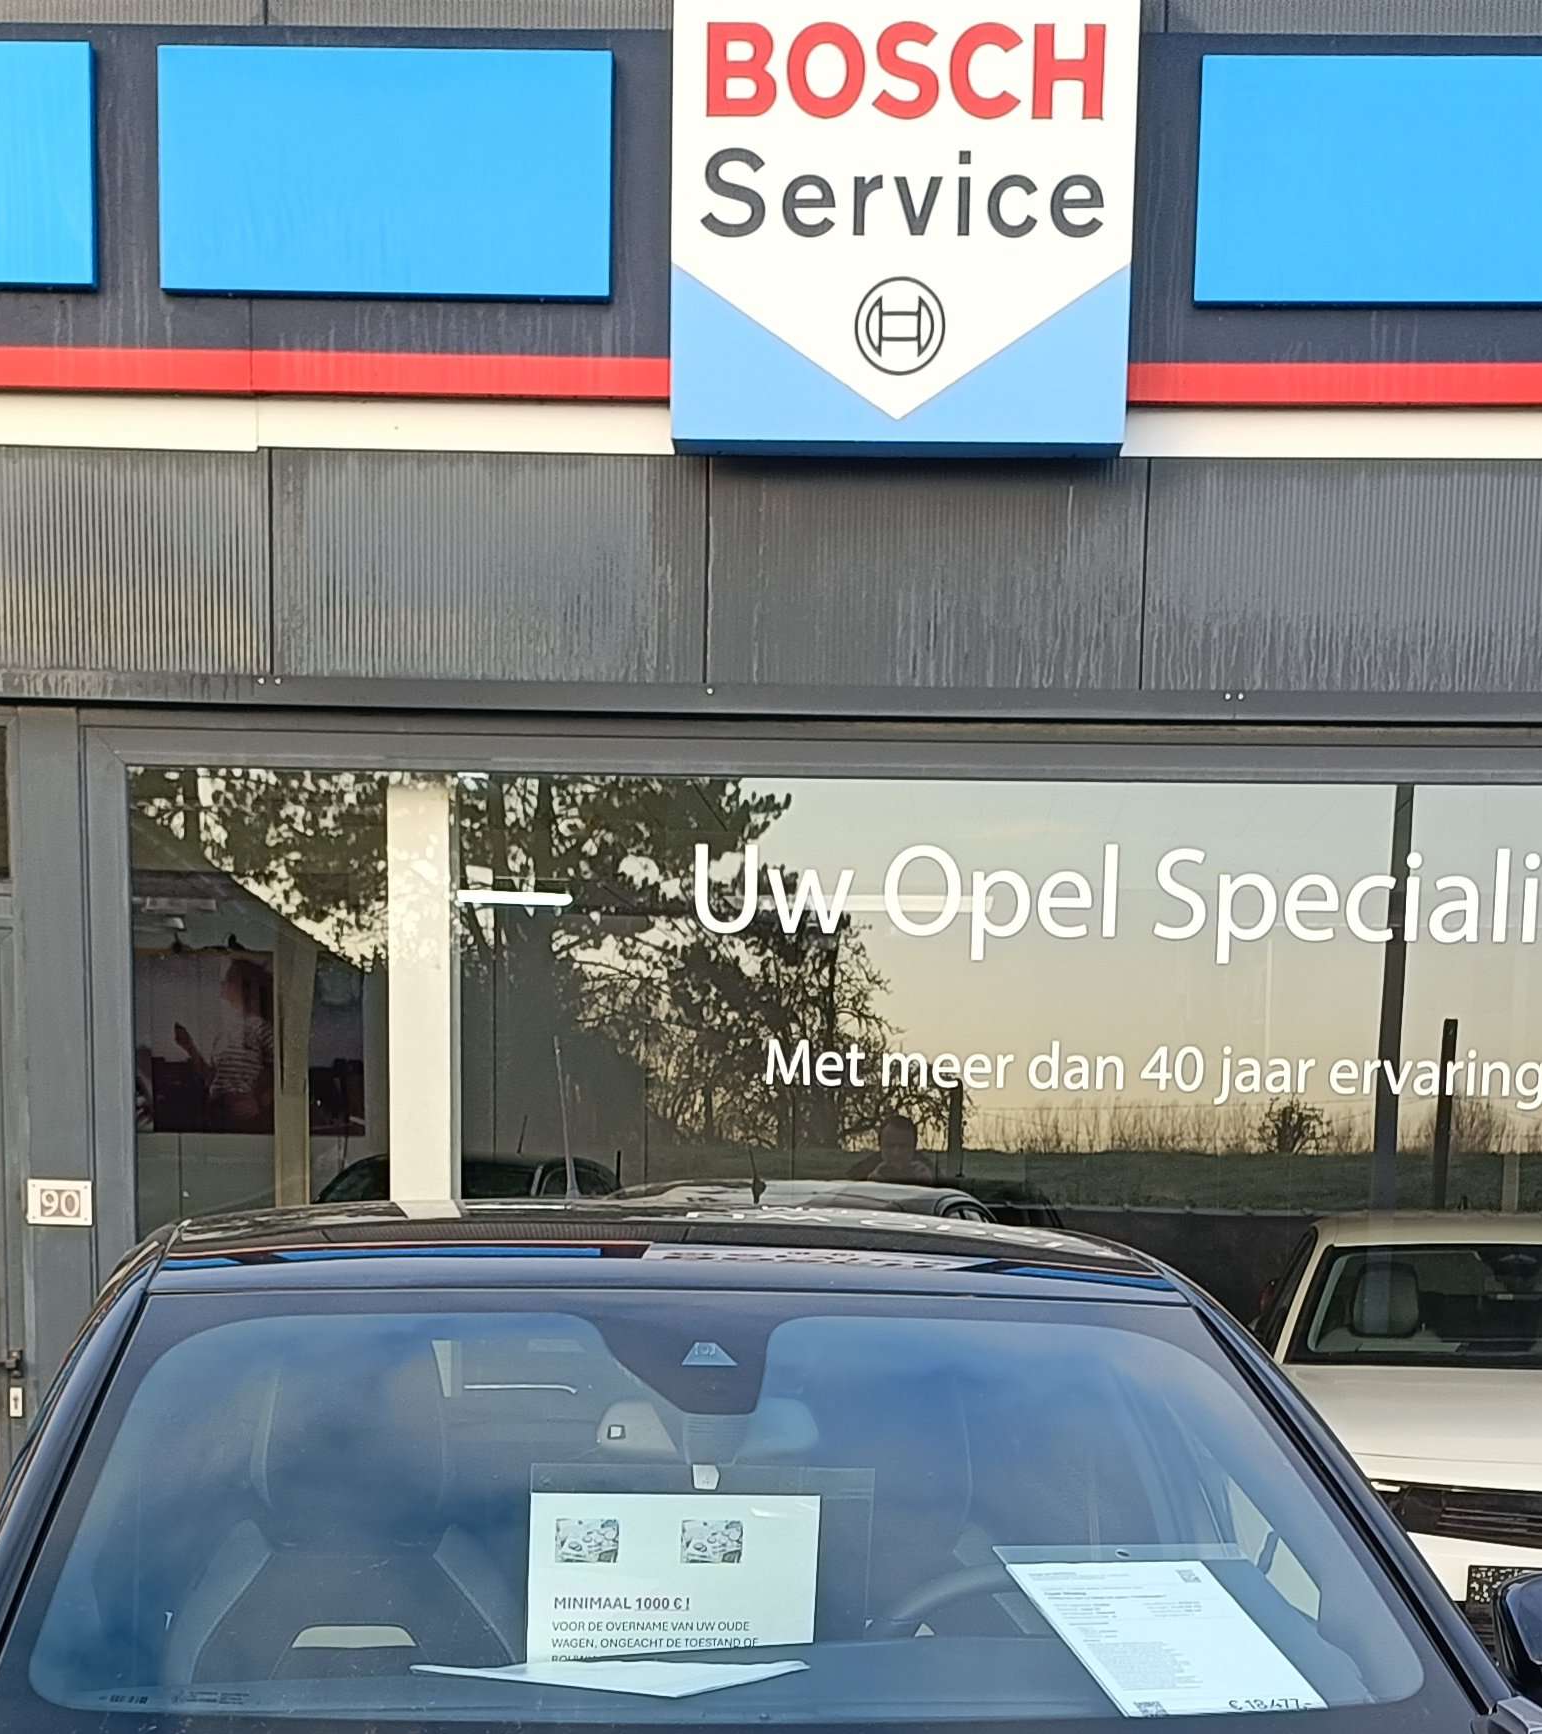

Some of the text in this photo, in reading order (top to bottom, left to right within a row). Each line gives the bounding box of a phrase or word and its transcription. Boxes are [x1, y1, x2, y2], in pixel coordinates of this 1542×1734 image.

[706, 21, 1106, 120] BOSCH
[700, 147, 1104, 238] Service
[693, 843, 855, 935] Uw
[884, 843, 1119, 961] Opel
[765, 1039, 865, 1088] Met
[881, 1052, 1014, 1089] meer
[1027, 1041, 1124, 1091] dan
[1140, 1046, 1205, 1092] 40
[1213, 1046, 1315, 1105] jaar
[41, 1190, 80, 1217] 90
[552, 1621, 750, 1631] VOOR DE OVERNAME VAN UW OUDE
[554, 1597, 631, 1609] MINIMAAL
[636, 1597, 669, 1610] 1000
[600, 1638, 663, 1648] ONGEACHT
[666, 1638, 681, 1648] DE
[685, 1638, 740, 1648] TOESTAND
[744, 1638, 758, 1648] OF
